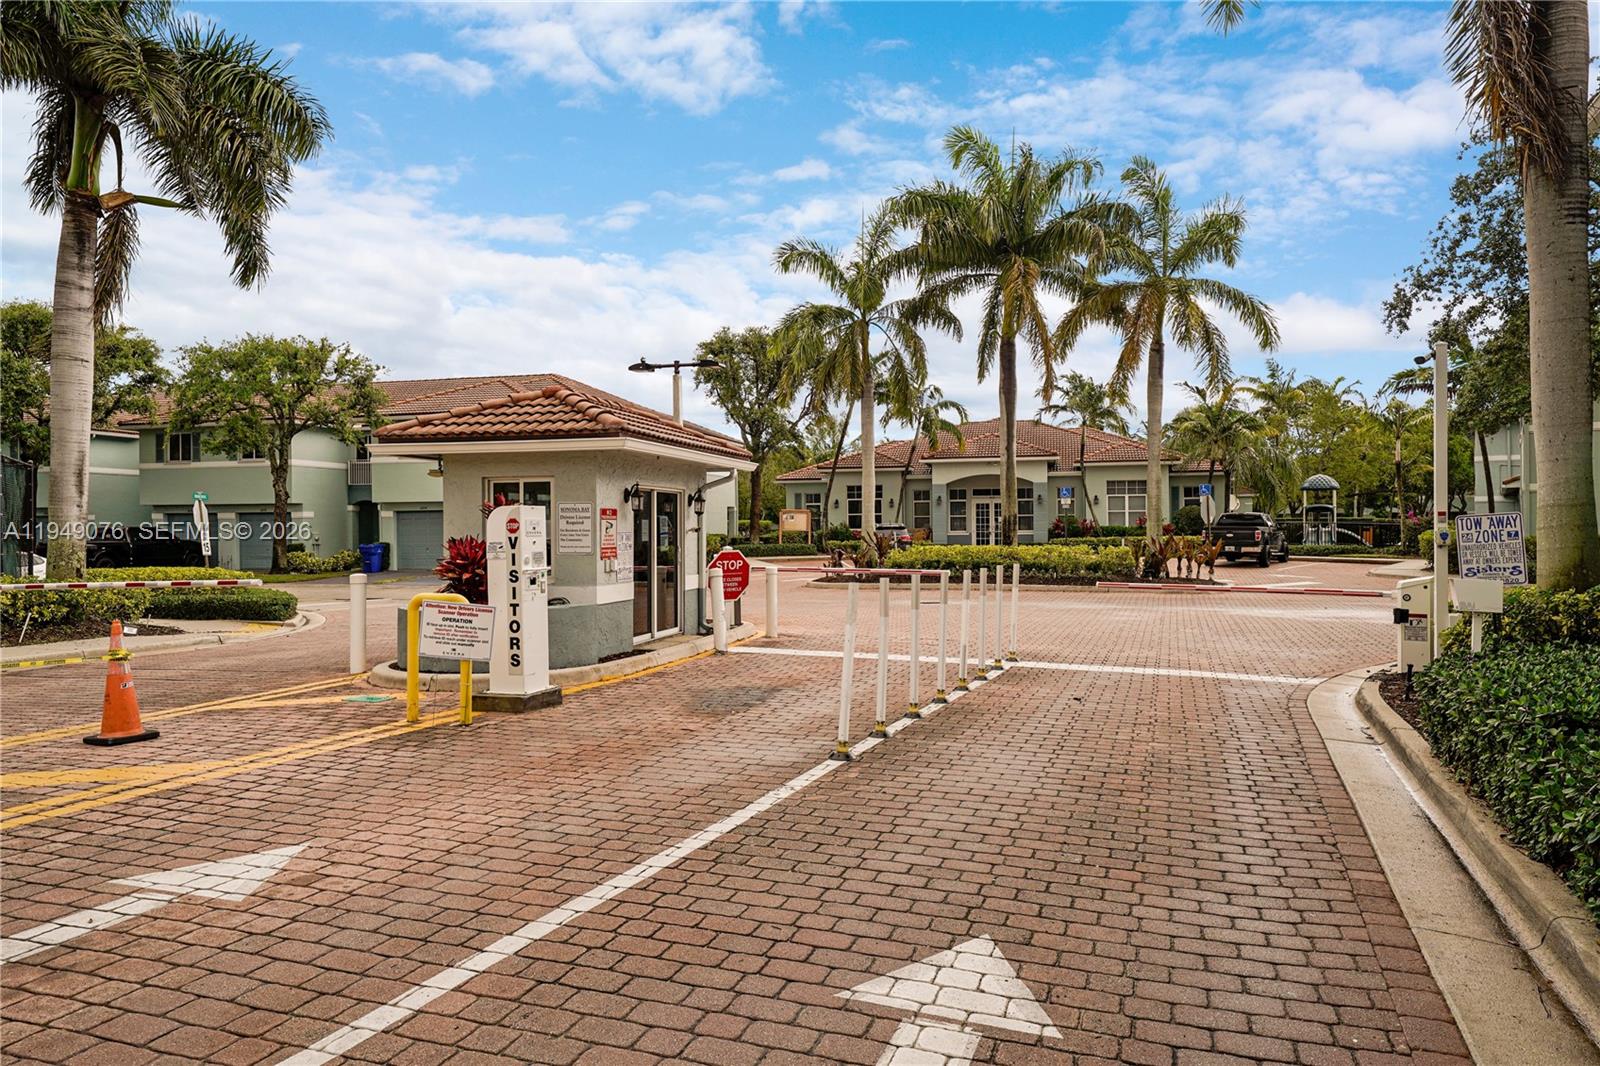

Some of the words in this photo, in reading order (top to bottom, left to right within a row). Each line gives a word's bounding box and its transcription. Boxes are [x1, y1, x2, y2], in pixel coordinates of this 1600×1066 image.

[1459, 517, 1482, 531] TOW
[1489, 515, 1518, 529] AWAY
[1475, 530, 1505, 543] ZONE
[716, 560, 743, 570] STOP
[508, 537, 521, 668] VISITORS
